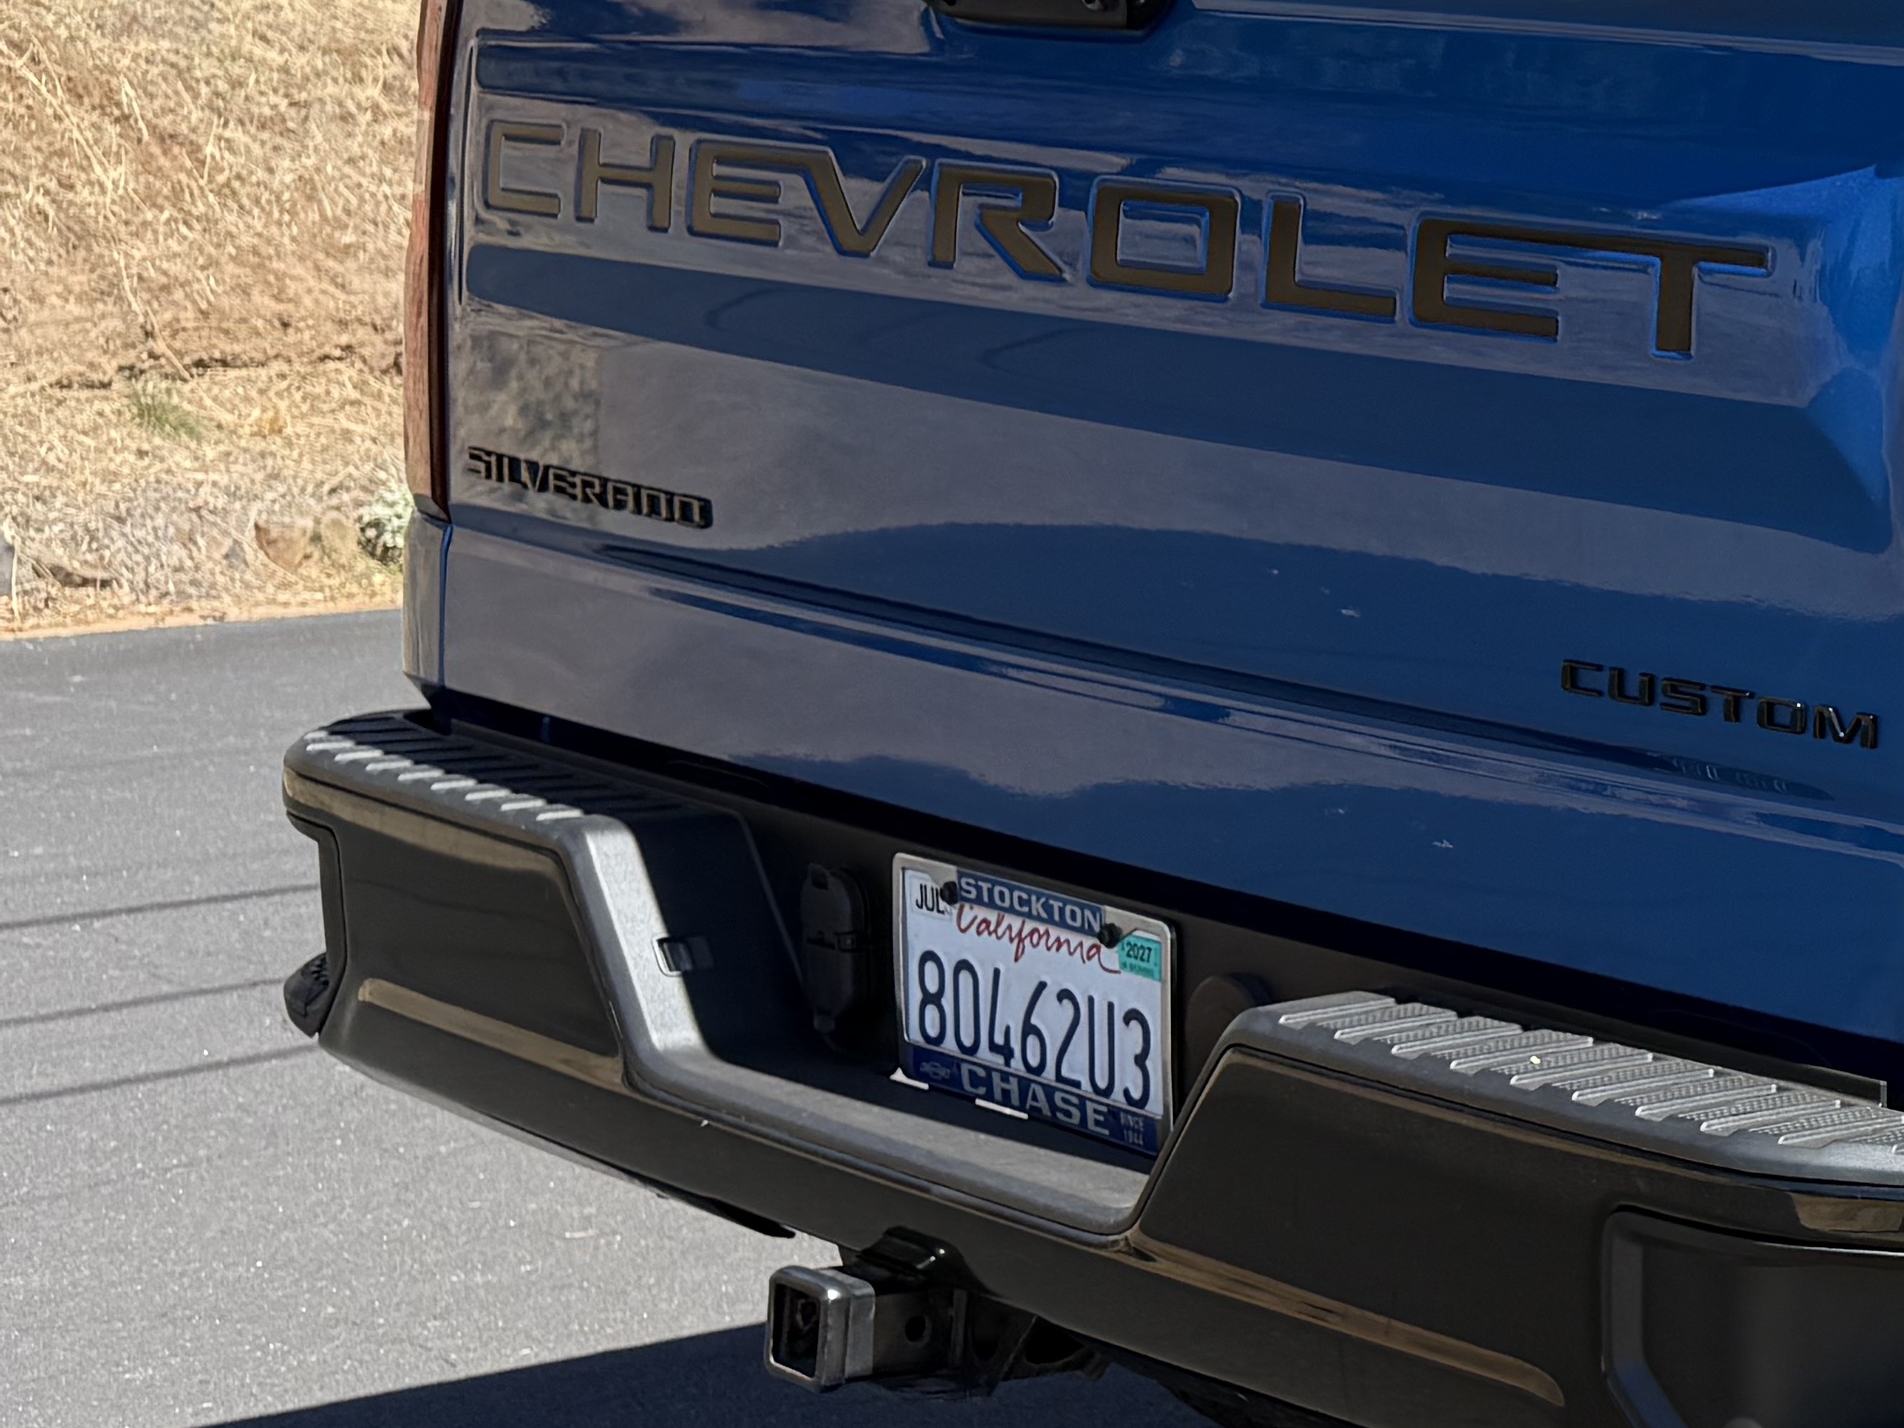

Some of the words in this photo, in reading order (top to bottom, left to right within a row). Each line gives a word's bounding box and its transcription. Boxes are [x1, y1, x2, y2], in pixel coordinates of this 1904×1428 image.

[477, 118, 1770, 357] CHEVROLET
[467, 446, 713, 529] SILVERADO
[1560, 659, 1879, 750] CUSTOM
[915, 883, 945, 915] JUL
[959, 876, 1101, 931] STOCKTON
[956, 903, 1122, 974] California
[1126, 941, 1152, 963] 2027
[918, 949, 1151, 1110] 80462U3
[960, 1062, 1111, 1135] CHASE
